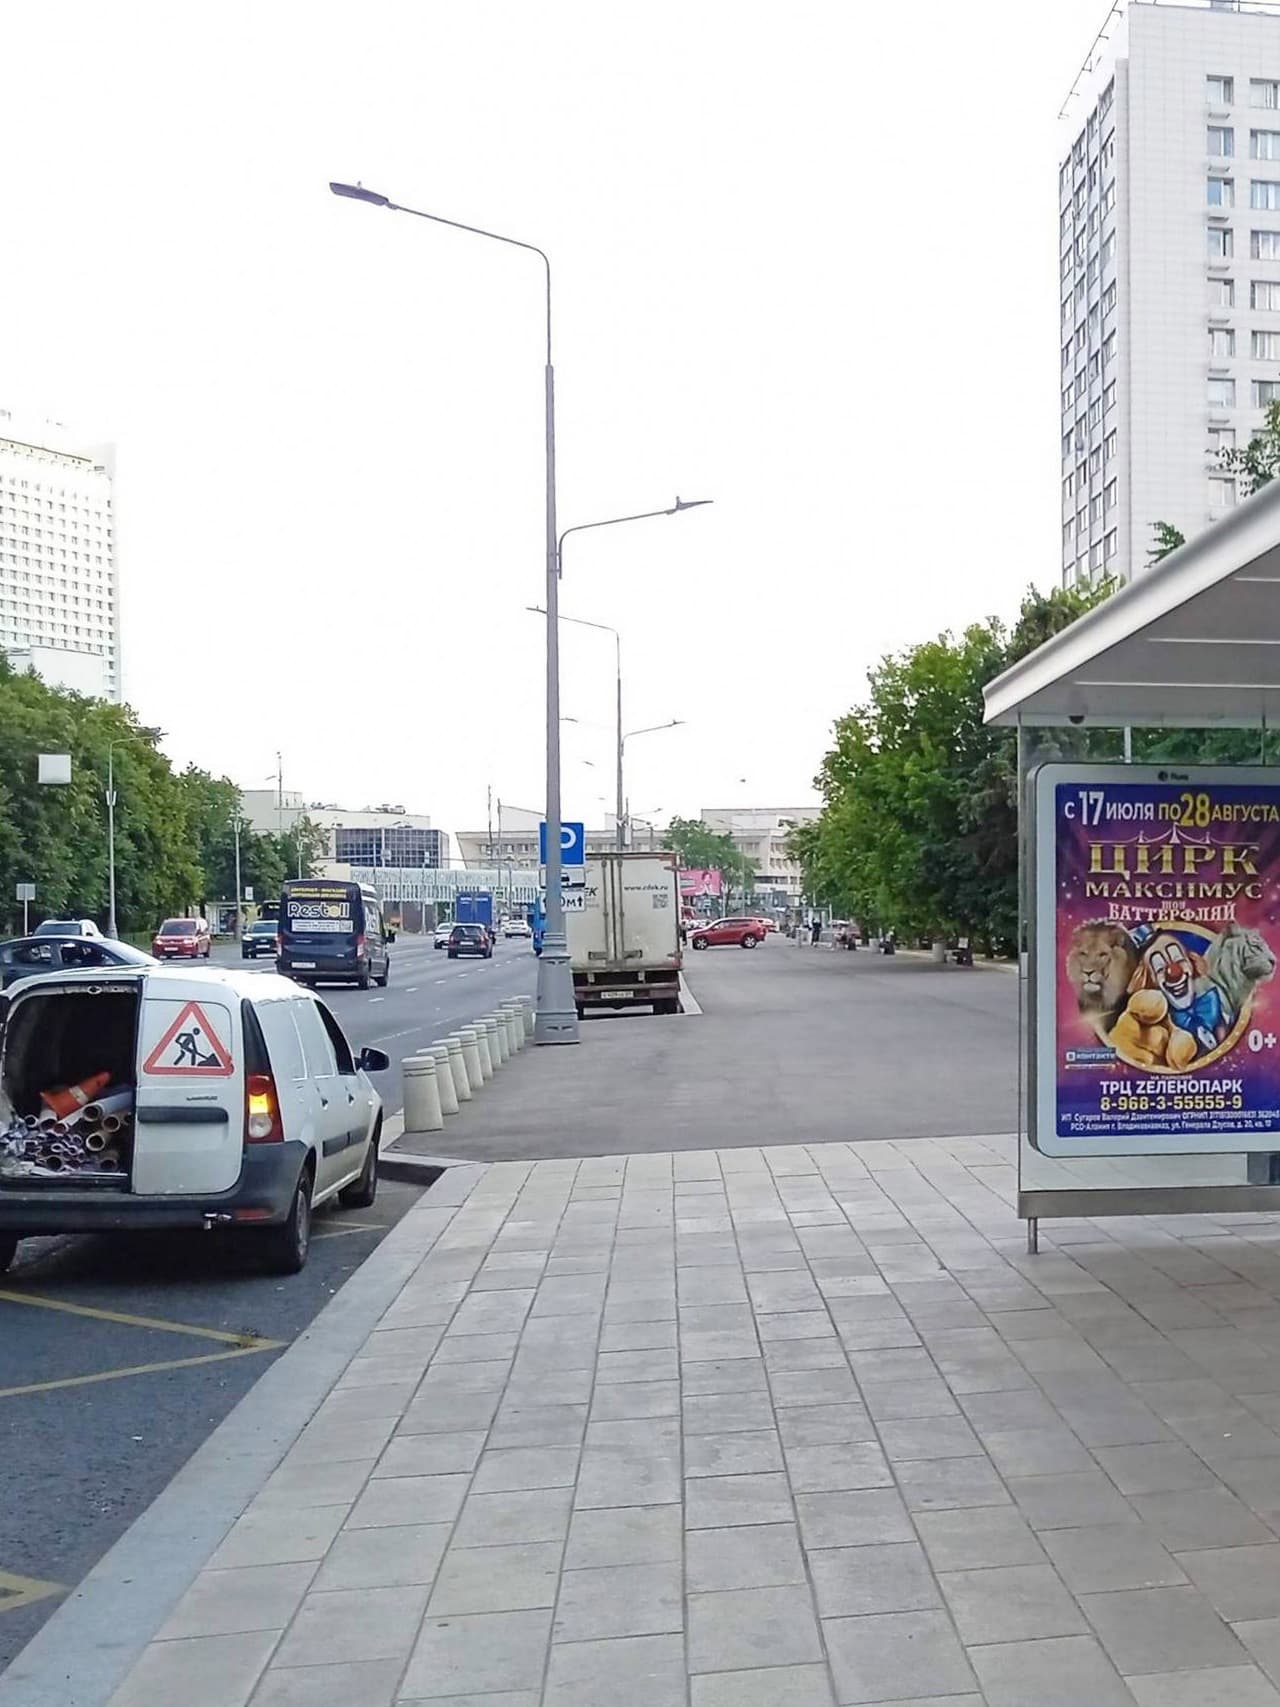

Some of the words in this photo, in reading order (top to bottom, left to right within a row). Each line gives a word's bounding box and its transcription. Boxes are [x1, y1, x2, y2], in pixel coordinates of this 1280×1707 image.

[1079, 791, 1104, 826] 17
[1106, 801, 1155, 821] ИЮЛЯ
[1158, 803, 1181, 821] ПО
[1181, 793, 1210, 827] 28
[1211, 804, 1280, 822] АВГУСТА
[1087, 843, 1260, 880] ЦИРК
[1086, 880, 1263, 899] МАКСИМУС
[287, 901, 350, 918] Restoll
[1108, 901, 1236, 921] БАТТЕРФЛЯЙ
[1248, 1029, 1277, 1052] 0+
[1100, 1081, 1132, 1096] ТРЦ
[1136, 1079, 1243, 1094] ZЕЛЕНОПАРК
[1100, 1095, 1243, 1111] 8-968-3-55555-9
